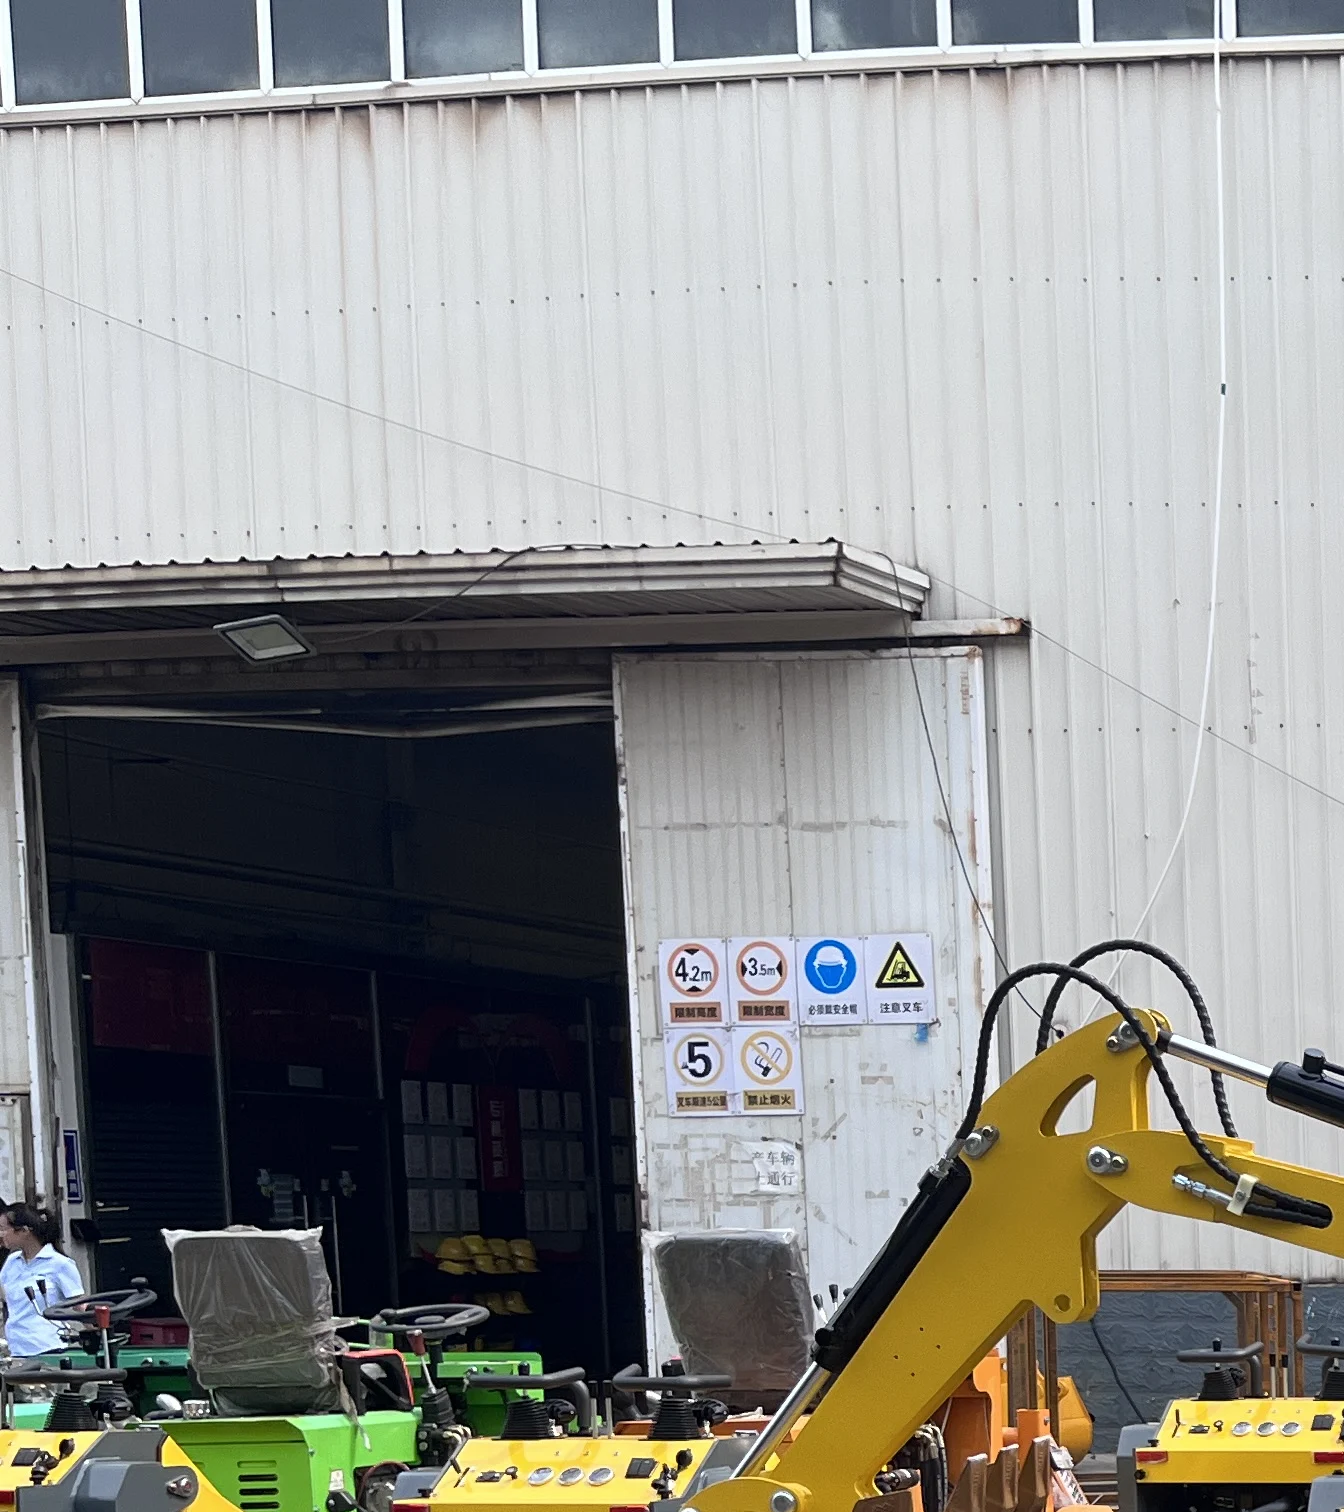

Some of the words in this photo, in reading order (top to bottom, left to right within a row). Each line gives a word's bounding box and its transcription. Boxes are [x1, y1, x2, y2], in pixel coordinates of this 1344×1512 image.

[674, 957, 712, 982] 4.2m
[748, 957, 776, 976] 3.5m
[880, 1001, 924, 1014] 注意叉车
[687, 1040, 712, 1078] 5
[747, 1094, 791, 1106] 禁止烟火
